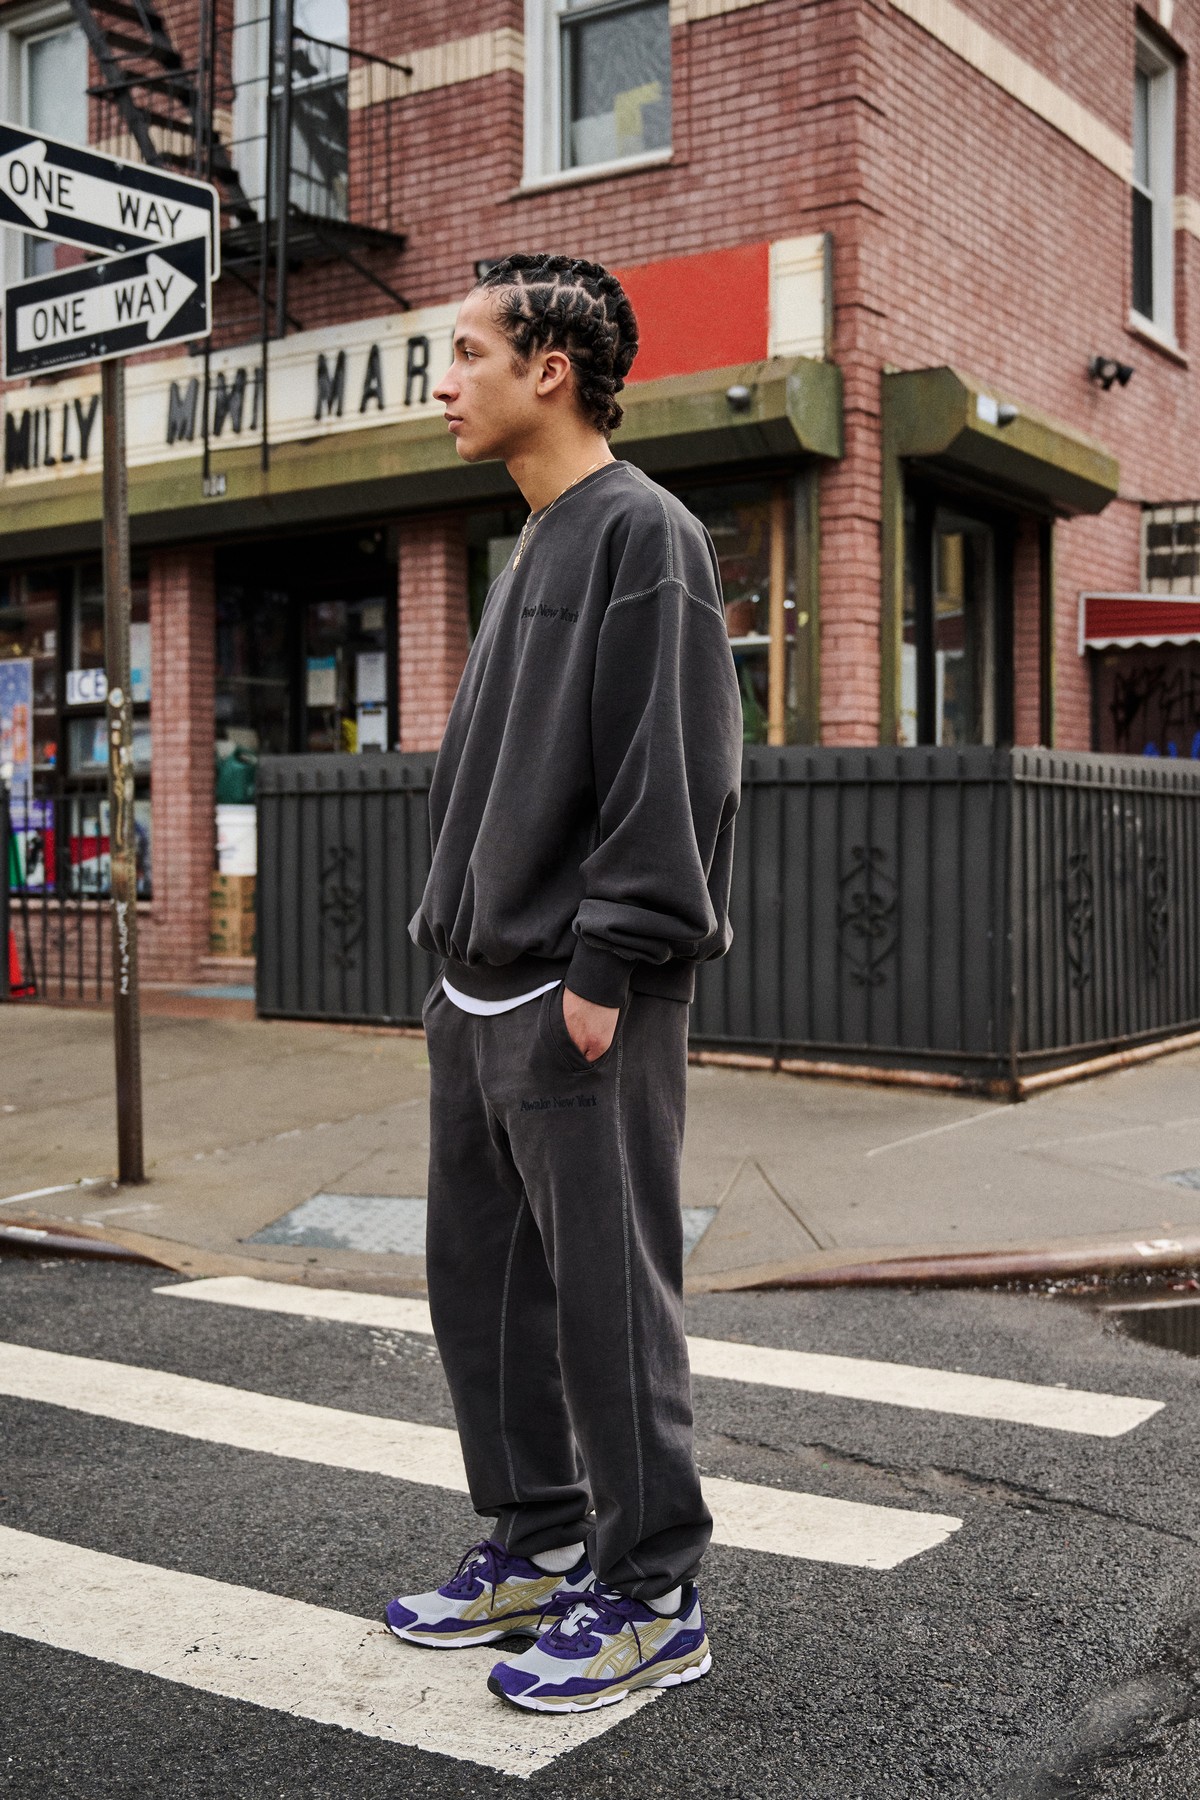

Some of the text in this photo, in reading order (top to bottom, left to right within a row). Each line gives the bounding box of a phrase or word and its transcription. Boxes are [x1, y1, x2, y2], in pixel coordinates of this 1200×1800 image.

[9, 160, 182, 243] ONE WAY
[32, 275, 175, 342] ONE WAY
[5, 331, 454, 474] MILLY MNI MAR
[539, 603, 559, 618] New
[68, 669, 107, 699] ICE
[520, 1094, 598, 1112] Awake New York
